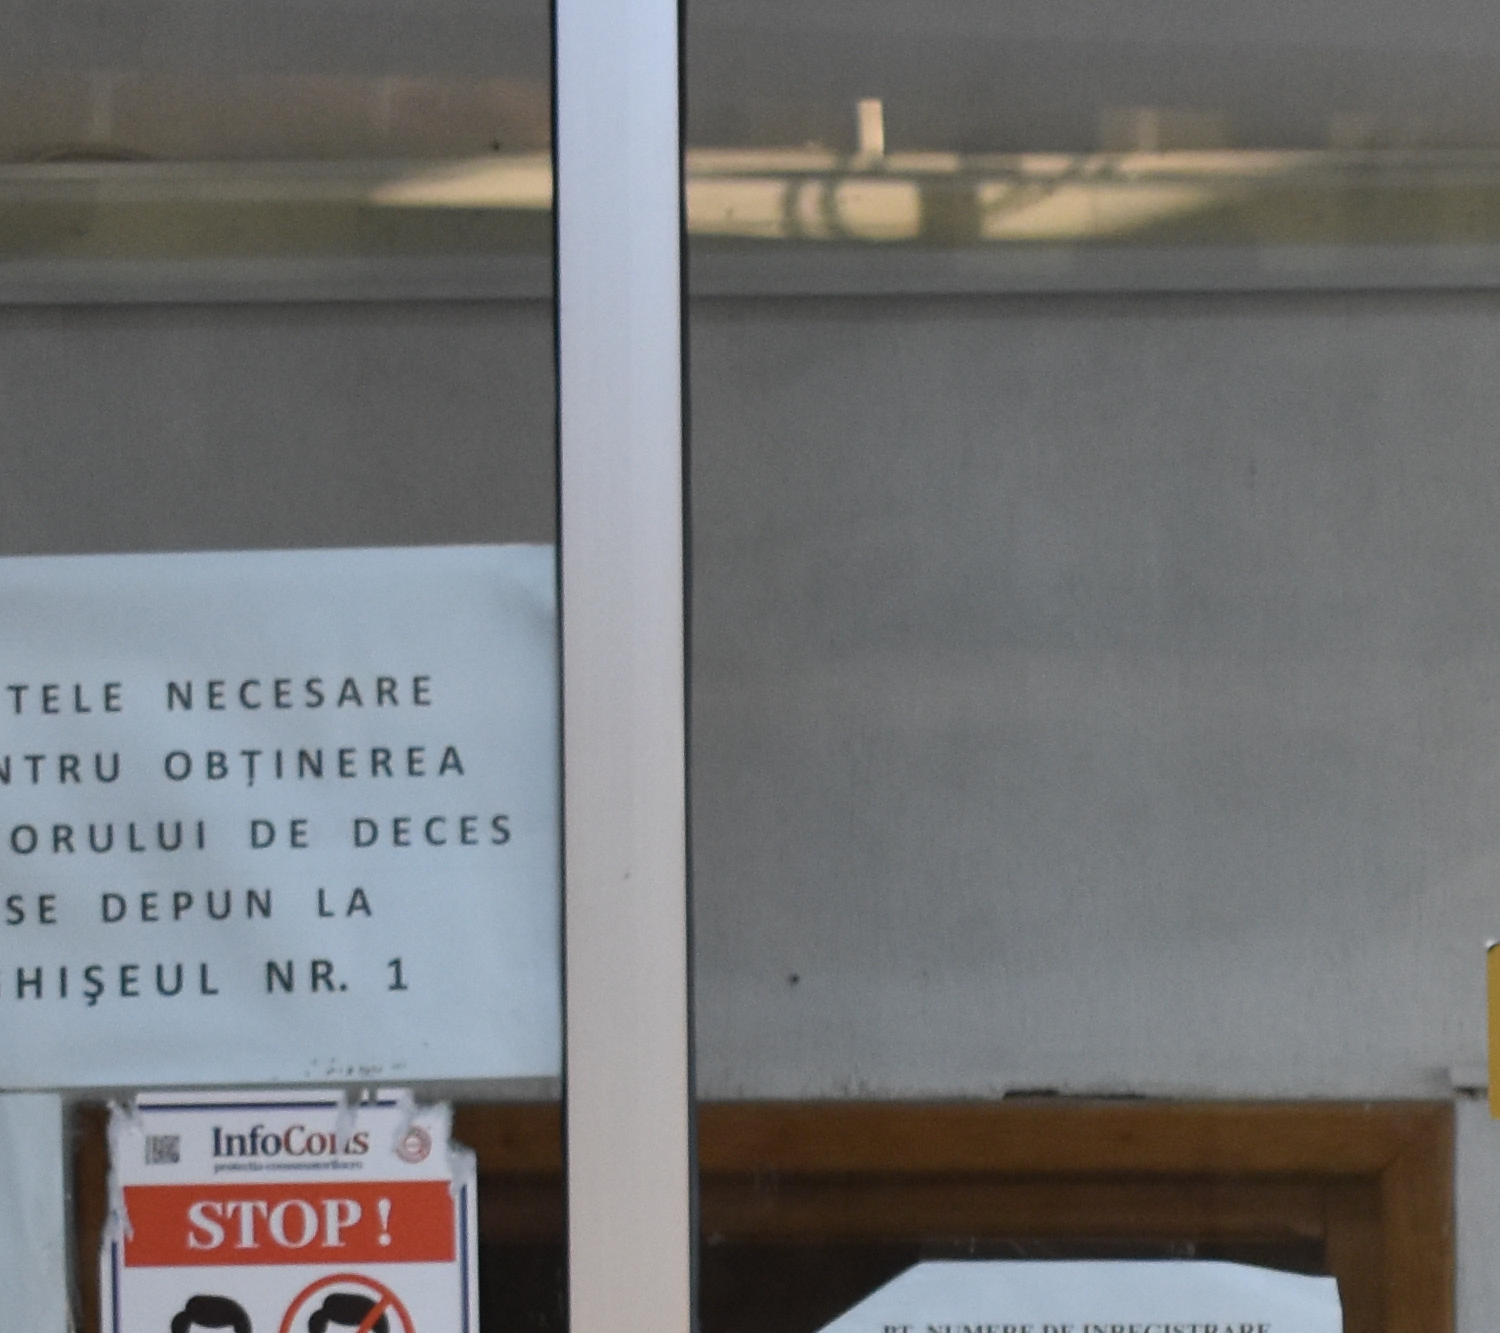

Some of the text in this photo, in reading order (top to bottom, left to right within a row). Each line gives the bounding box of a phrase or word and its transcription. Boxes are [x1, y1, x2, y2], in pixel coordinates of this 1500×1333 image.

[167, 676, 430, 710] NECESARE
[251, 819, 307, 849] DE
[354, 815, 510, 847] DECES
[6, 888, 371, 925] SE DEPUN LA
[266, 960, 347, 993] NR.
[389, 958, 407, 990] 1
[187, 1199, 362, 1250] STOP
